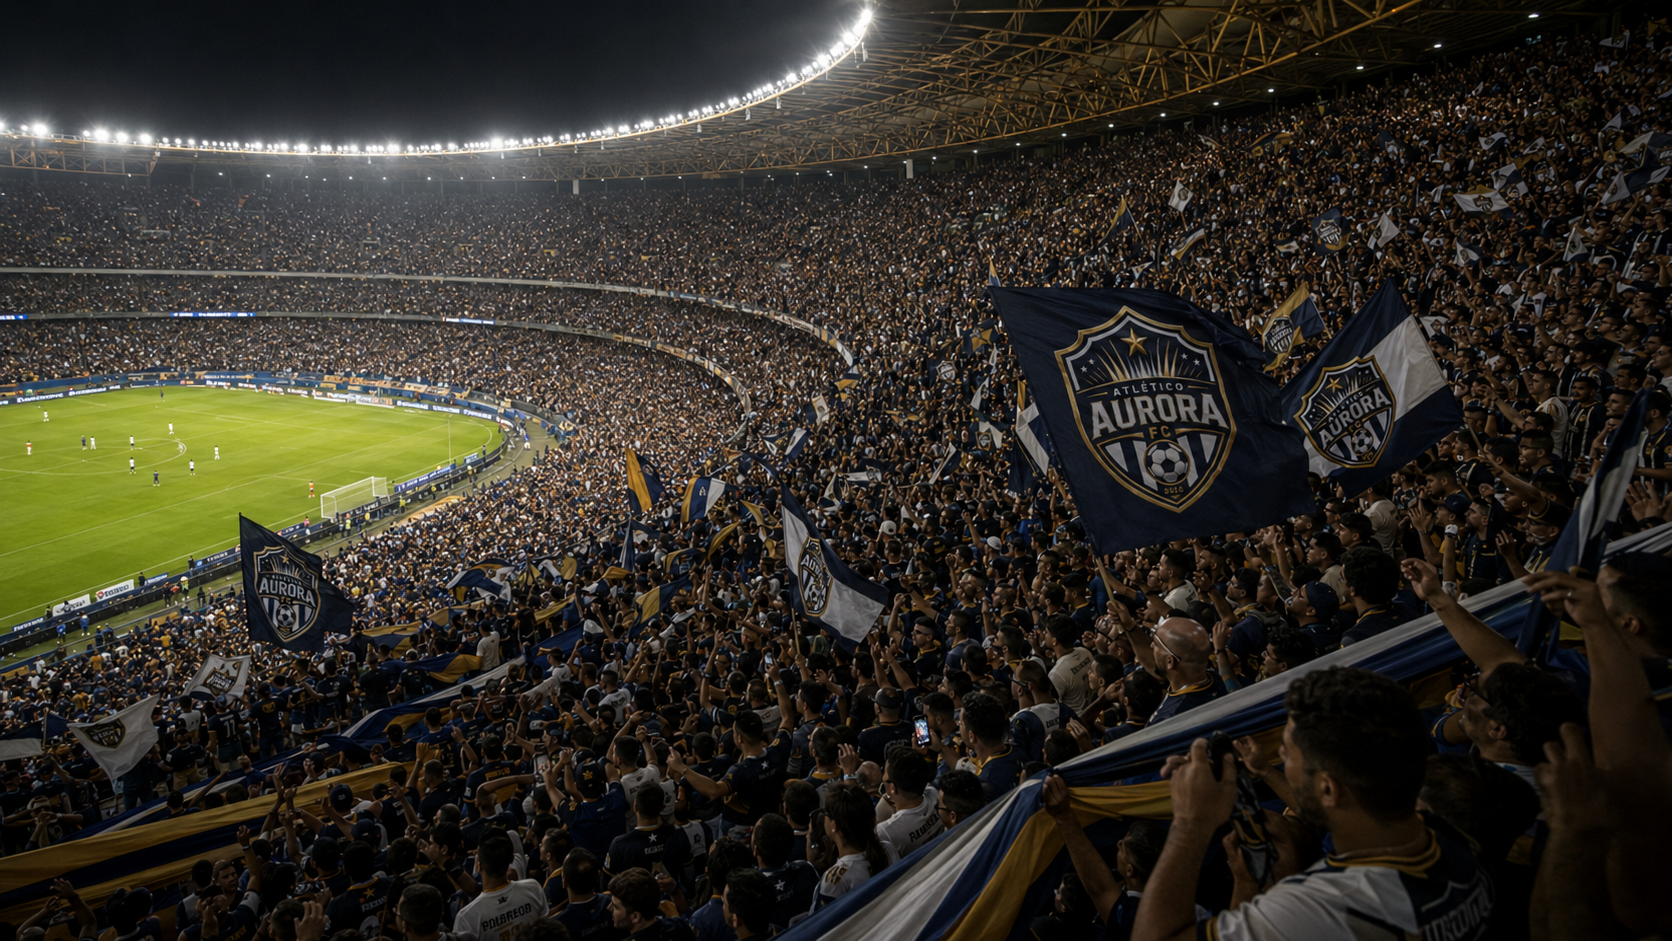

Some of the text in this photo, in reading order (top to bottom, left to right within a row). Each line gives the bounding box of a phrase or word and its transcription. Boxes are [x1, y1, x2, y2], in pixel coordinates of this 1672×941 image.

[1113, 381, 1184, 397] ATLÉTICO
[1091, 393, 1230, 440] AURORA
[1148, 425, 1171, 439] FC
[1319, 387, 1392, 451] AURORA
[259, 577, 316, 608] AURORA
